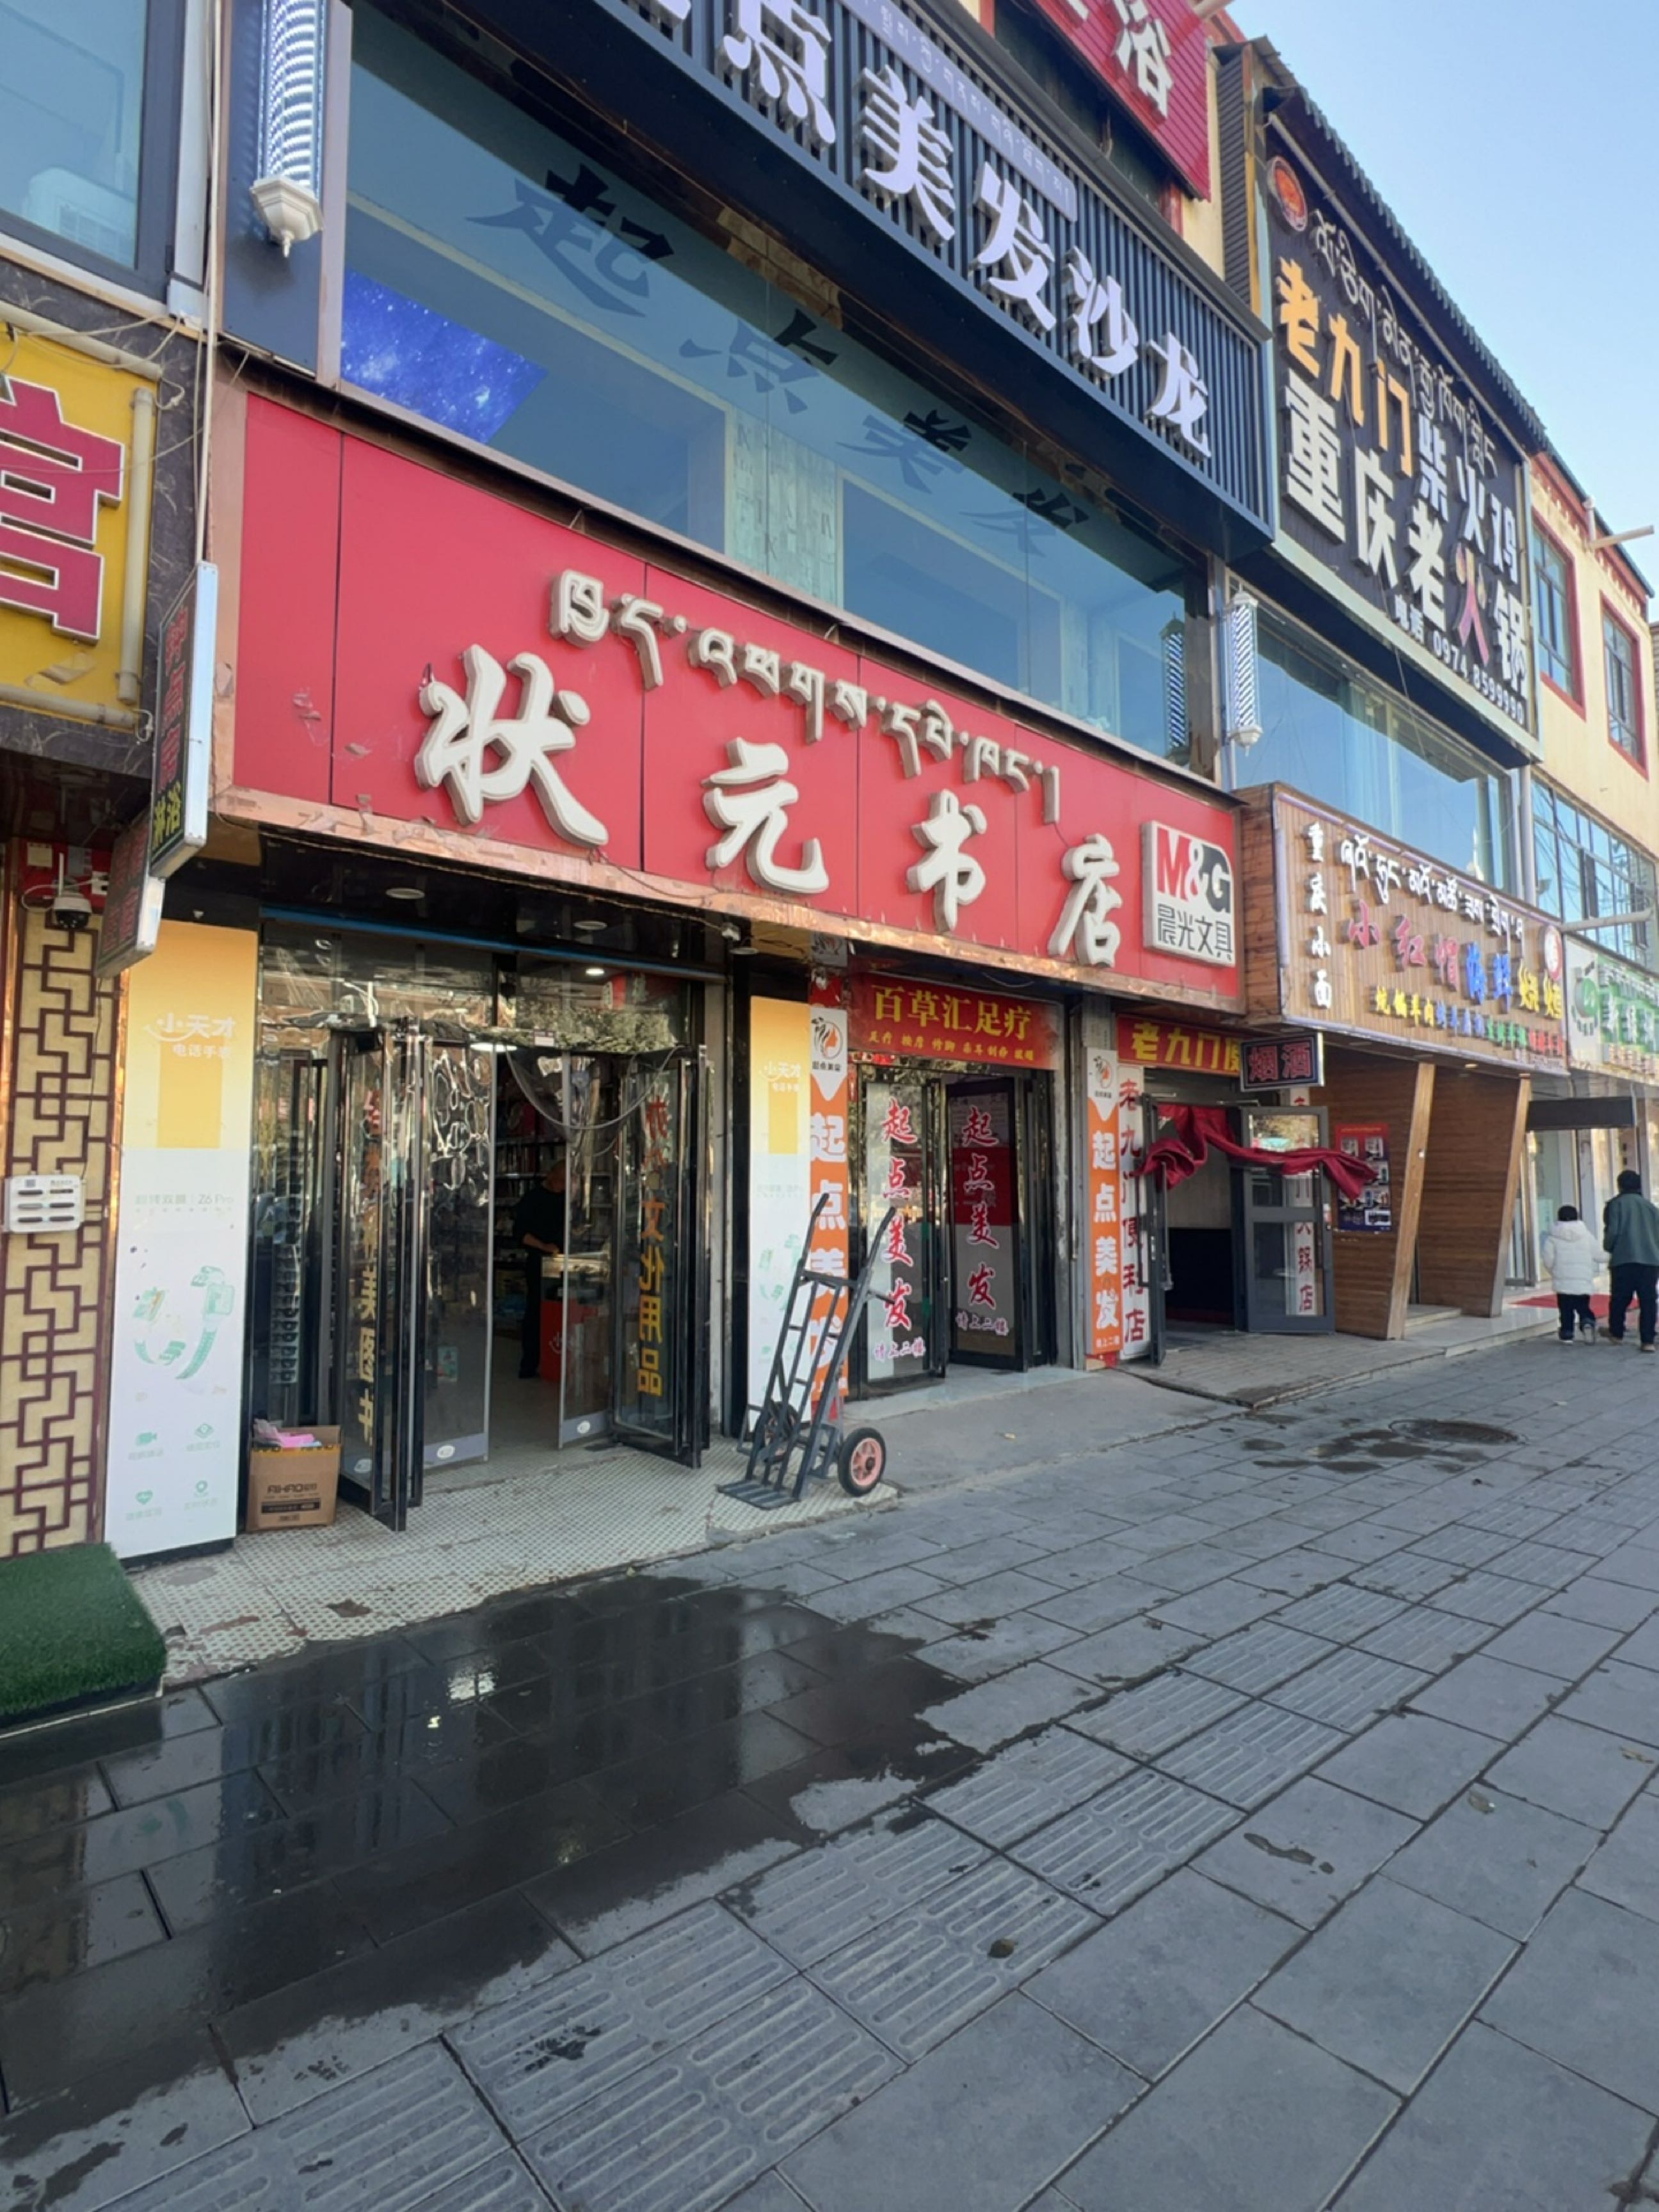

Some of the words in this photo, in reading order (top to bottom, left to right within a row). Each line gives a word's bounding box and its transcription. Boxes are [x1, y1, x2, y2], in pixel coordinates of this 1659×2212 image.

[630, 0, 1212, 460] 点美发沙龙
[1285, 369, 1529, 703] 重庆老火锅
[1432, 629, 1468, 679] 0974
[415, 644, 1123, 968] 状元书店
[1156, 826, 1233, 915] M&G
[1157, 902, 1233, 962] 晨光文具
[152, 1013, 236, 1039] 小天才
[870, 984, 1032, 1041] 百草汇足疗
[1247, 1040, 1312, 1082] 烟酒
[881, 1097, 918, 1330] 起点美发
[961, 1104, 1000, 1310] 起点美发
[1093, 1130, 1119, 1331] 起点美发
